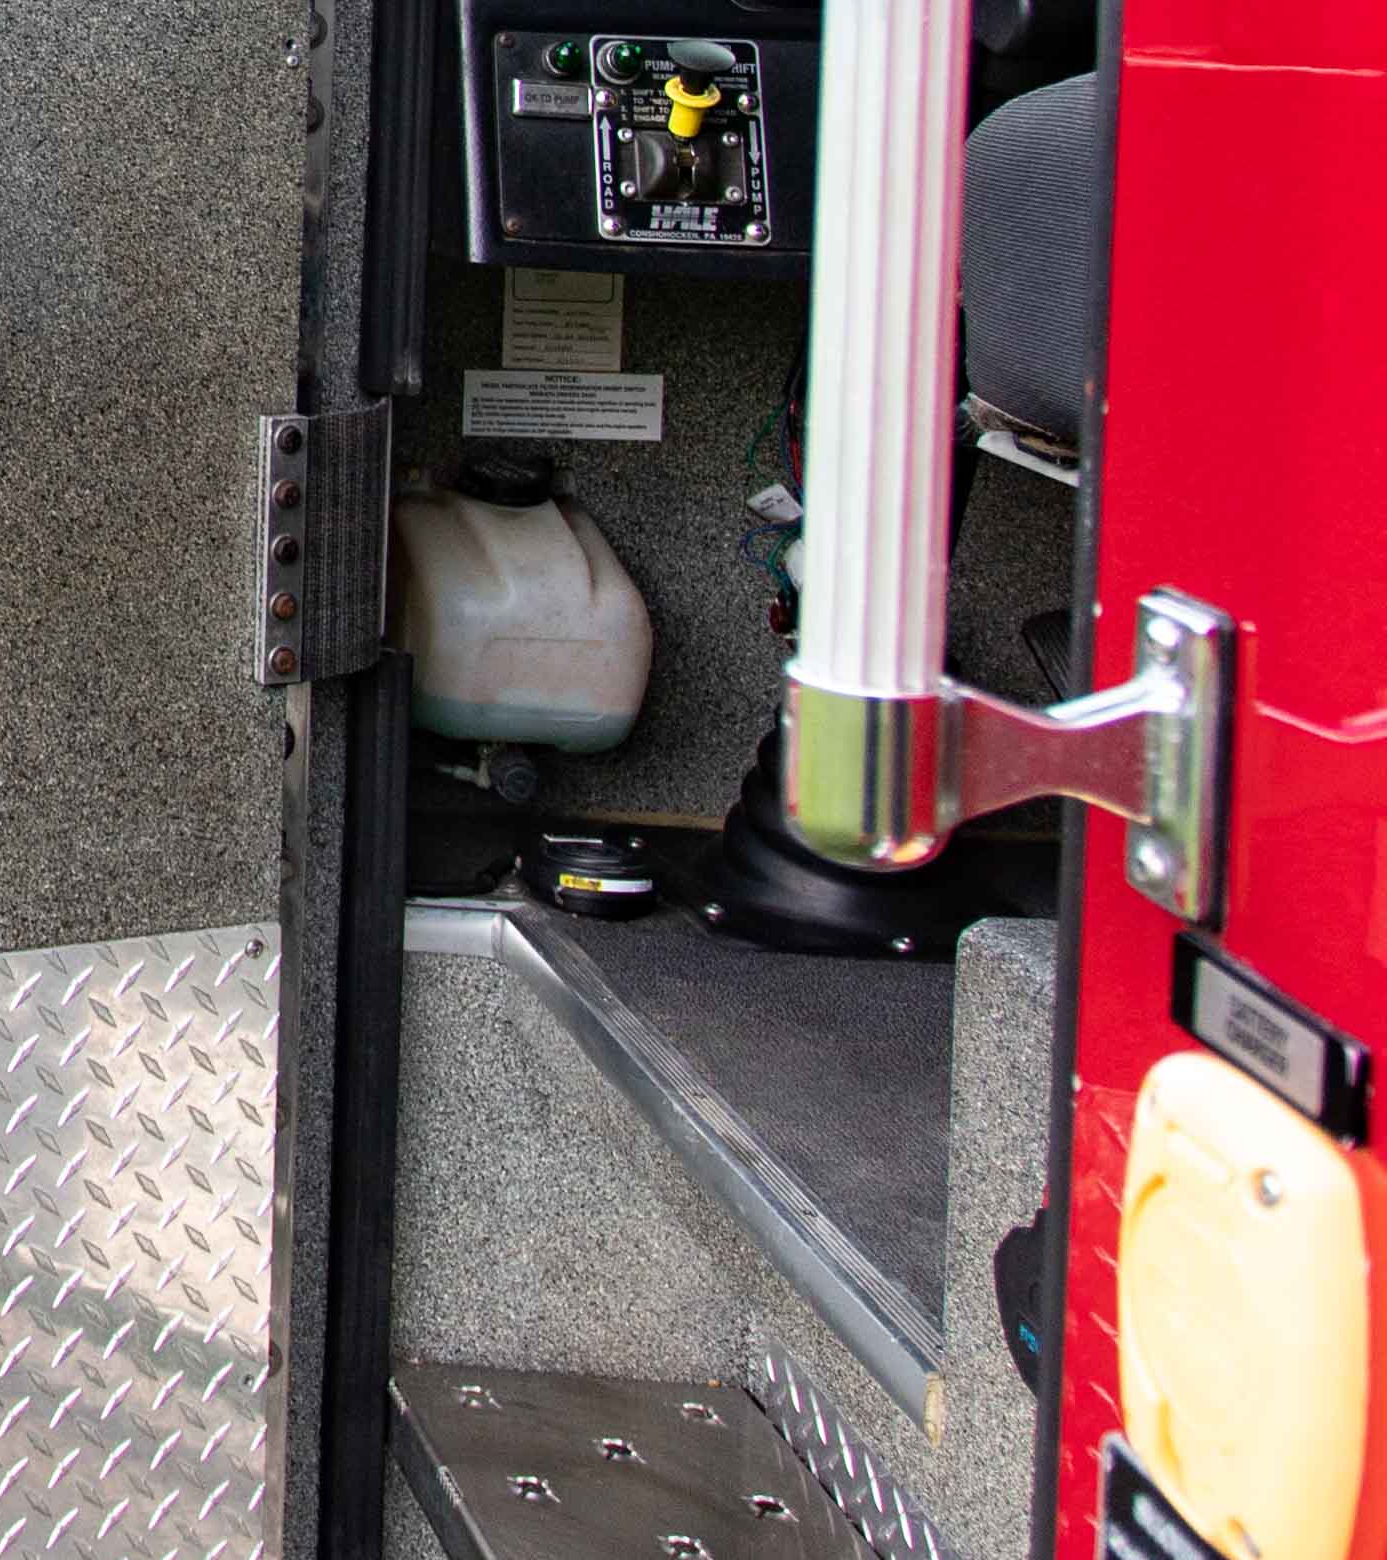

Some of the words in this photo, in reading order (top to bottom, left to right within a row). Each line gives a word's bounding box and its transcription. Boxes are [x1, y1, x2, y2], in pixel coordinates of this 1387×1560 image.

[731, 63, 756, 74] HIFT
[603, 162, 614, 209] ROAD
[751, 167, 763, 215] PUMP
[650, 205, 719, 231] HALE
